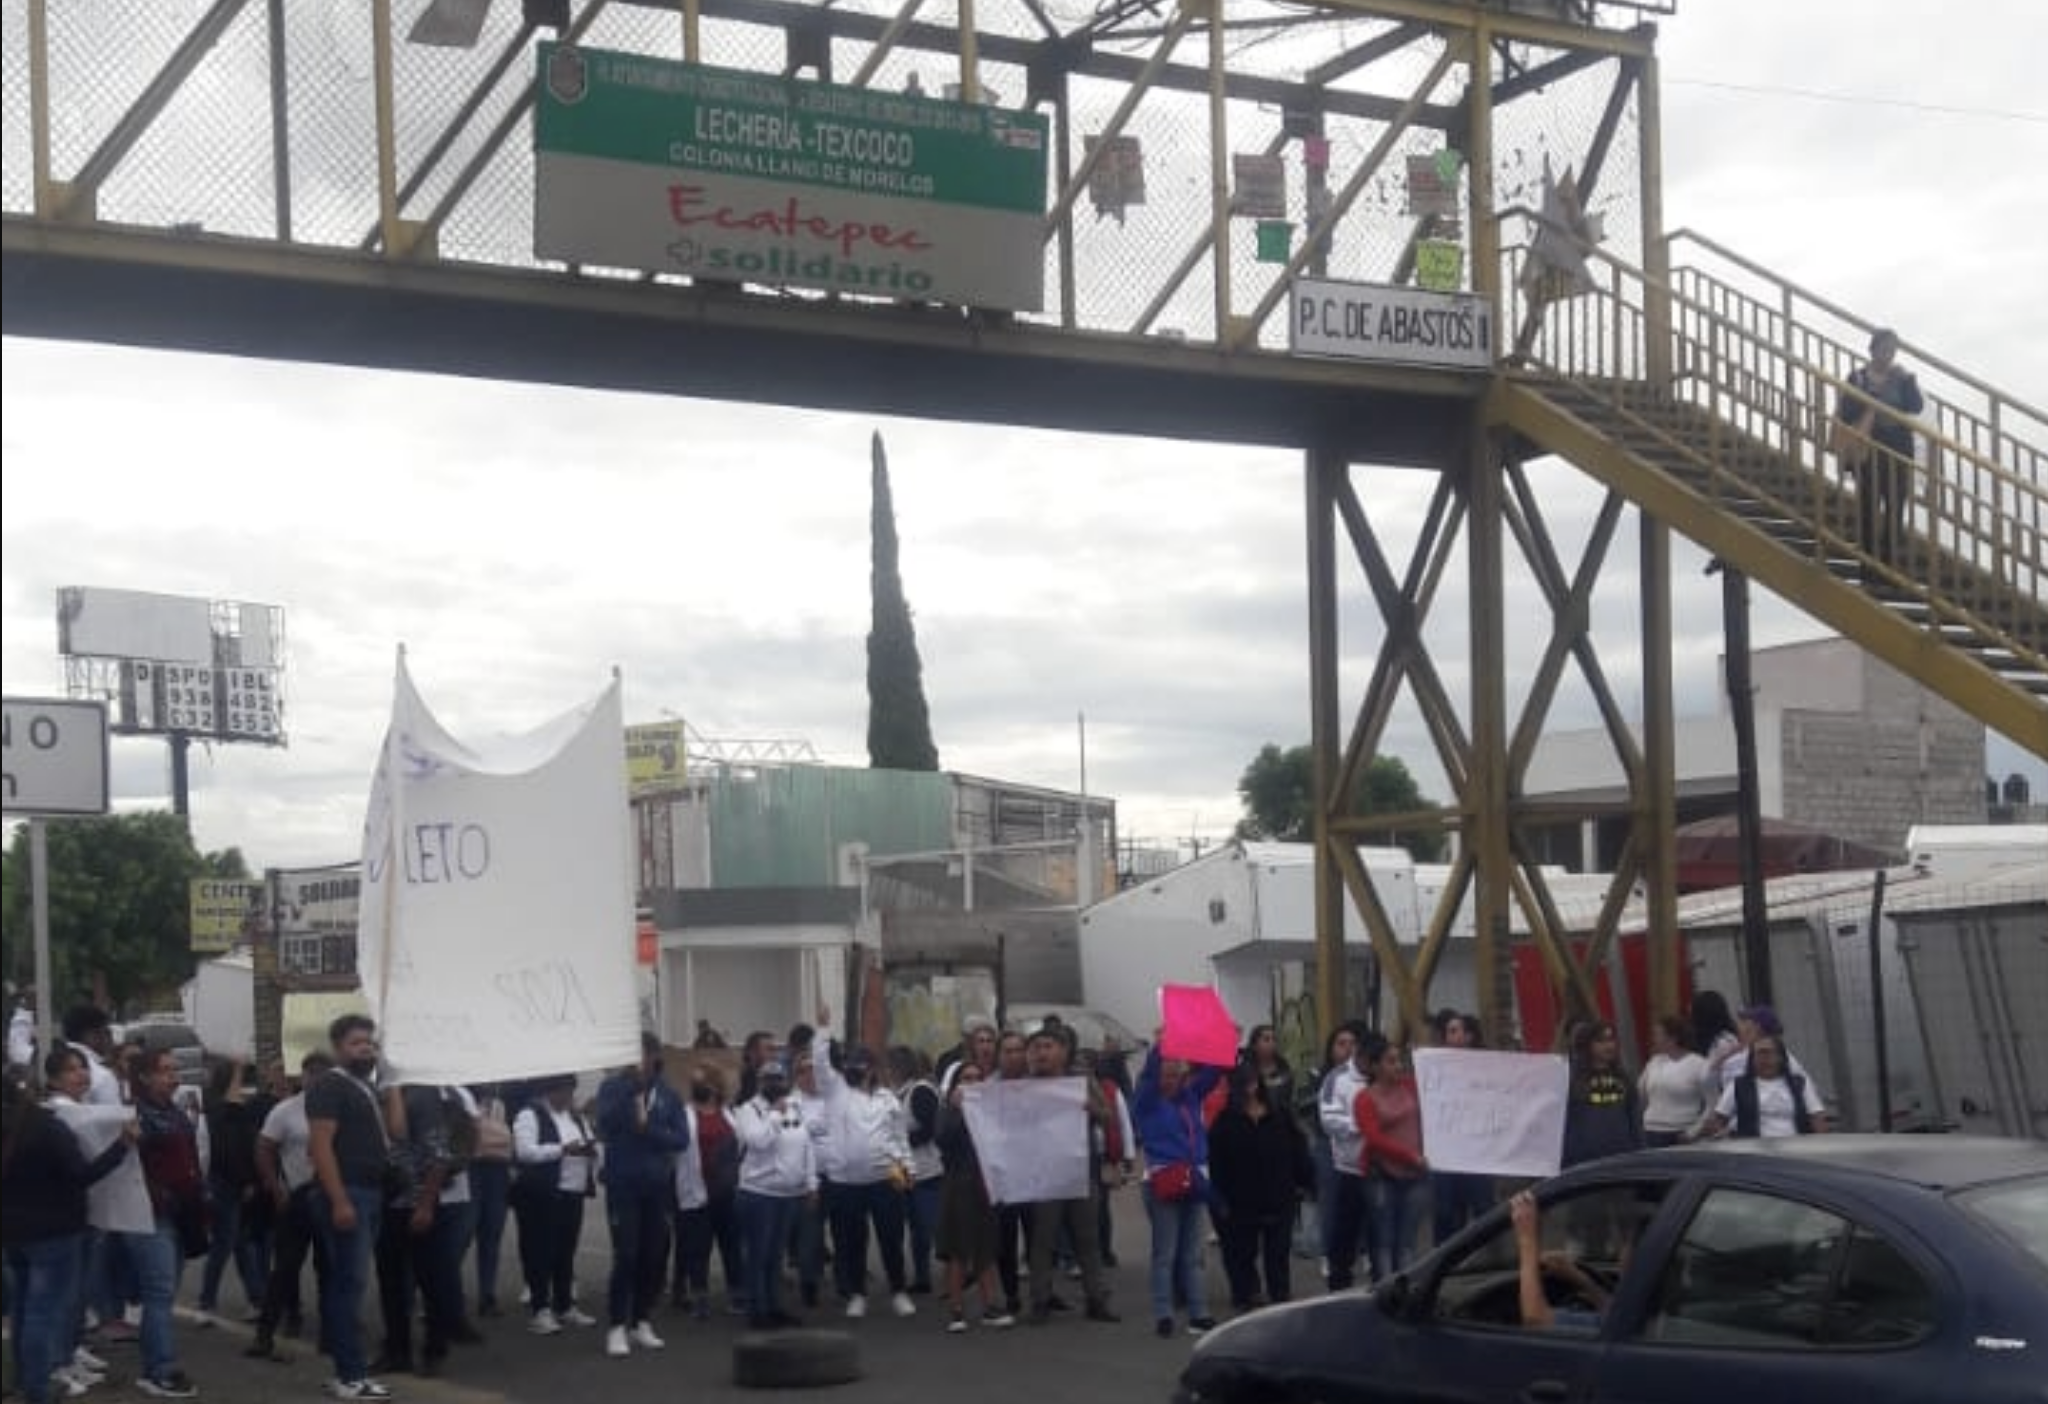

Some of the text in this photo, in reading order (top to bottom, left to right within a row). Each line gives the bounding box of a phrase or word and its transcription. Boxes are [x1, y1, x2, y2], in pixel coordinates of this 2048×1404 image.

[669, 142, 754, 171] COLONIA
[822, 162, 847, 183] DE
[850, 167, 935, 194] MORELOS
[667, 184, 935, 258] Ecatepec
[707, 247, 932, 291] solidario
[1377, 304, 1474, 350] ABASTOS
